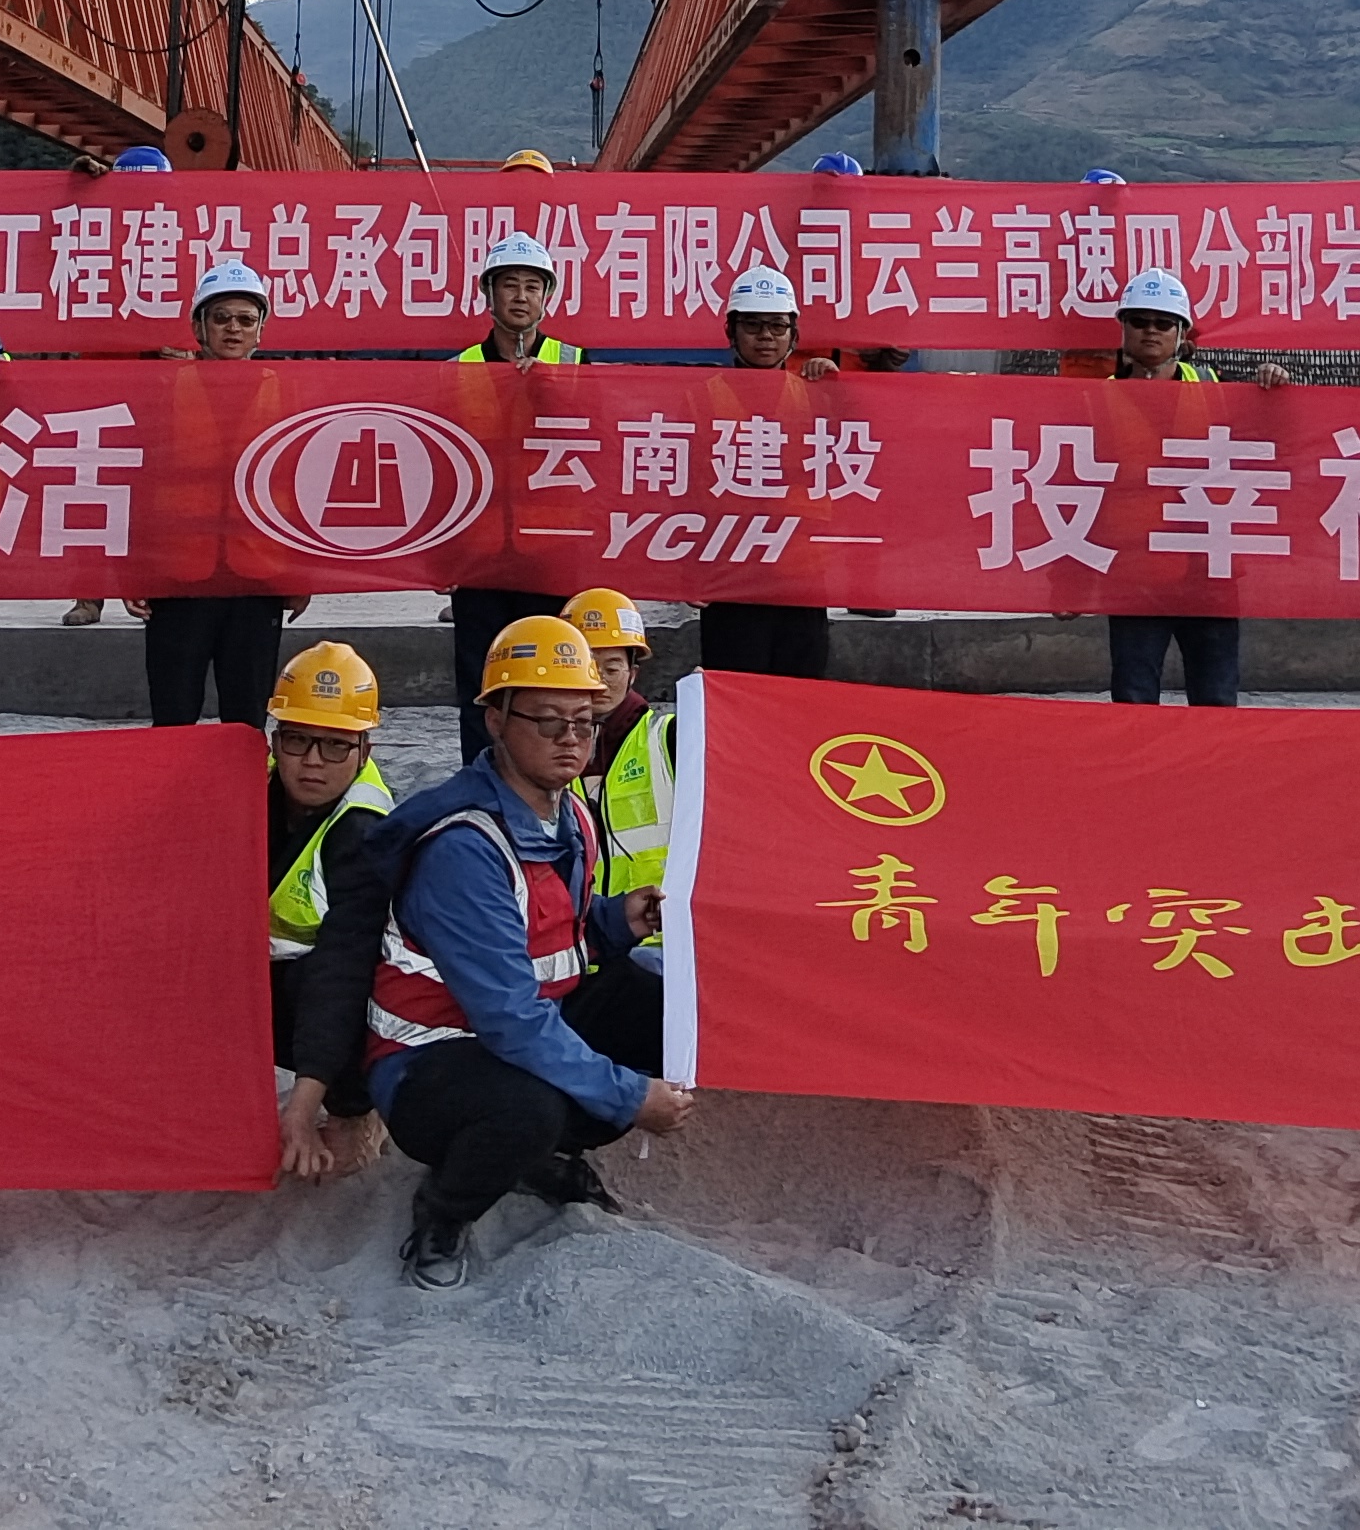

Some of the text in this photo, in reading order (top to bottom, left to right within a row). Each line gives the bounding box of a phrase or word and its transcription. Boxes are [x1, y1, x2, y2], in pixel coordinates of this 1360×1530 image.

[522, 411, 883, 503] 云南建投
[601, 511, 801, 564] YCIH
